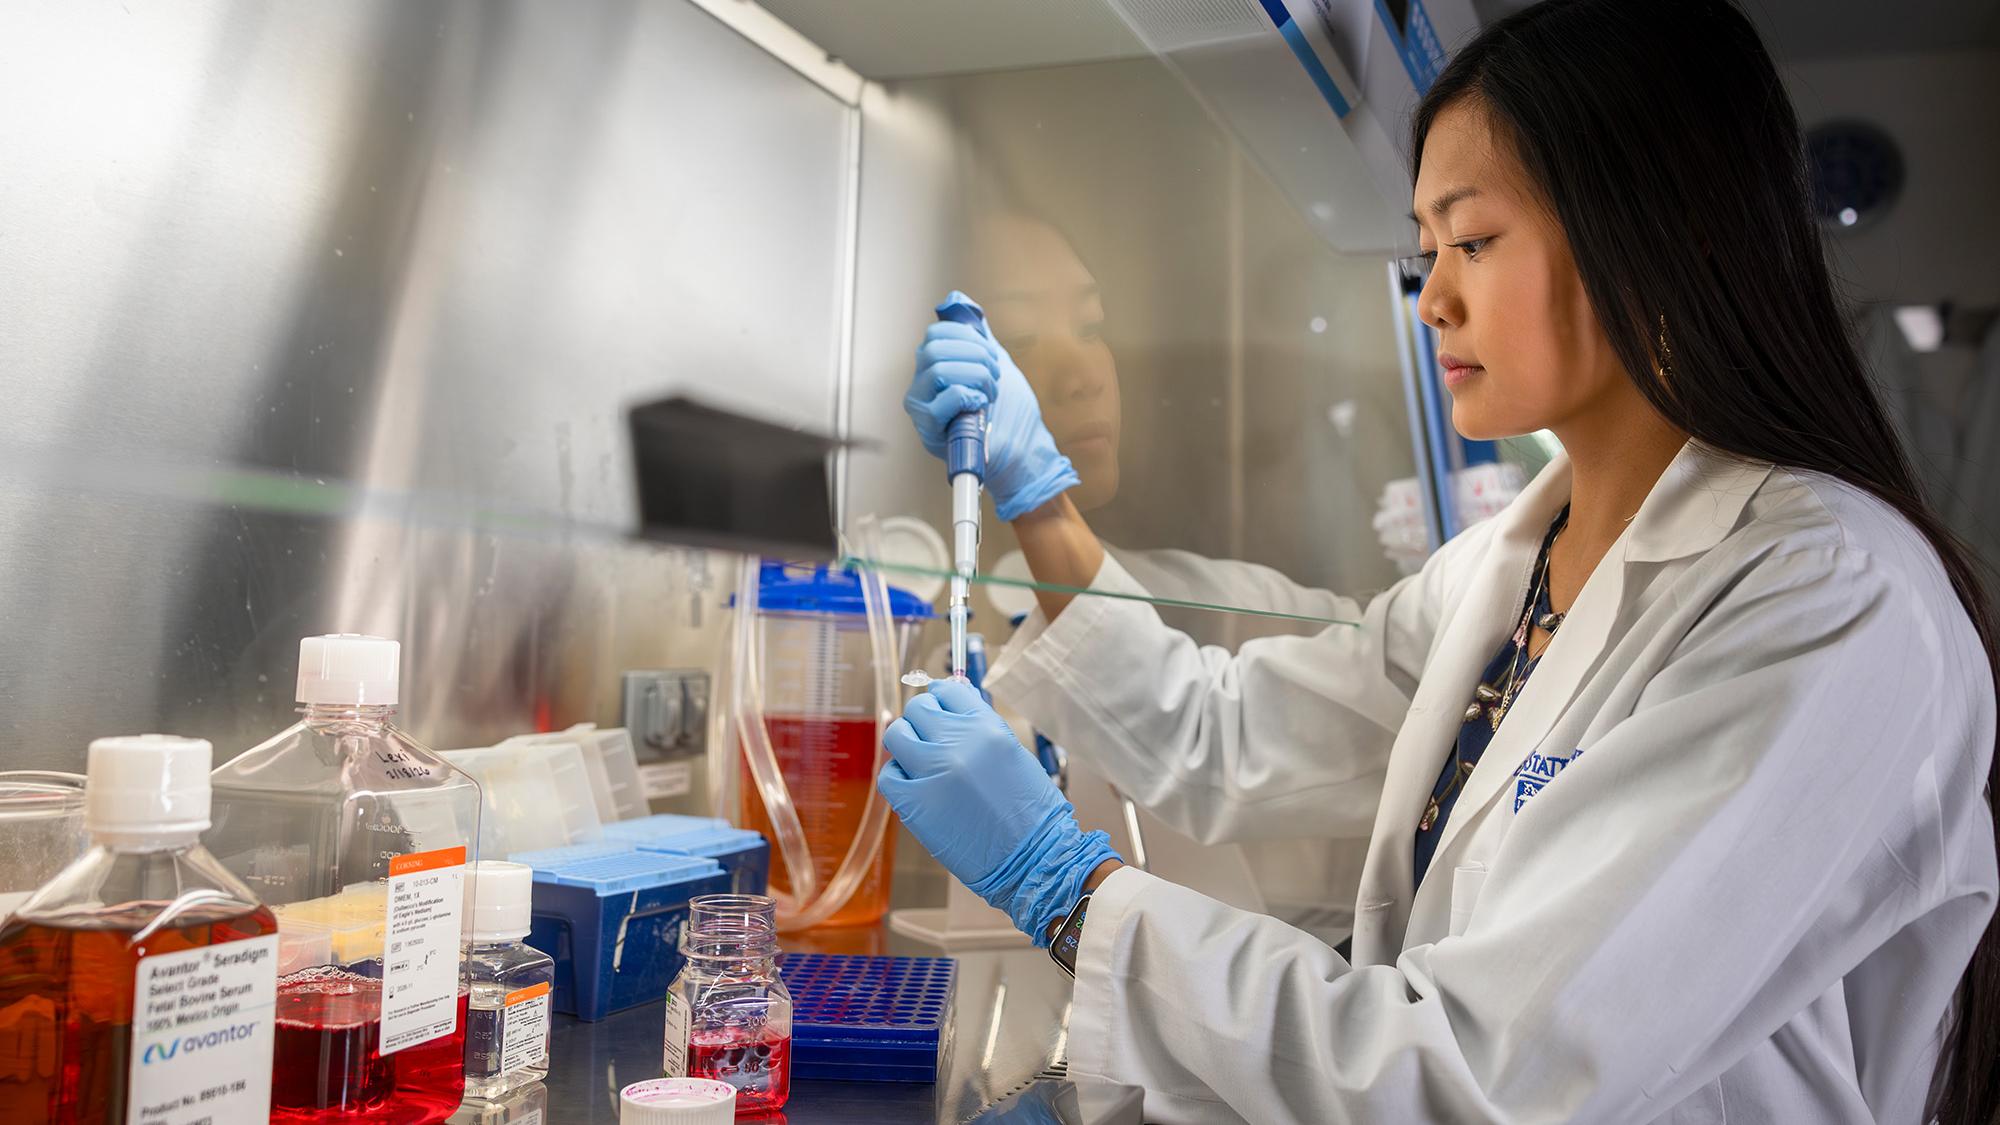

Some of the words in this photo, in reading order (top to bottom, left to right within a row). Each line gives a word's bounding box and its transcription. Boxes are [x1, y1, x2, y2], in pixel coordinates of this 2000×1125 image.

[214, 949, 268, 967] Seradigm
[149, 981, 184, 996] Select
[187, 974, 220, 989] Grade
[146, 1001, 175, 1015] Fetal
[179, 992, 216, 1008] Bovine
[220, 983, 253, 998] Serum
[183, 1022, 256, 1054] avantor
